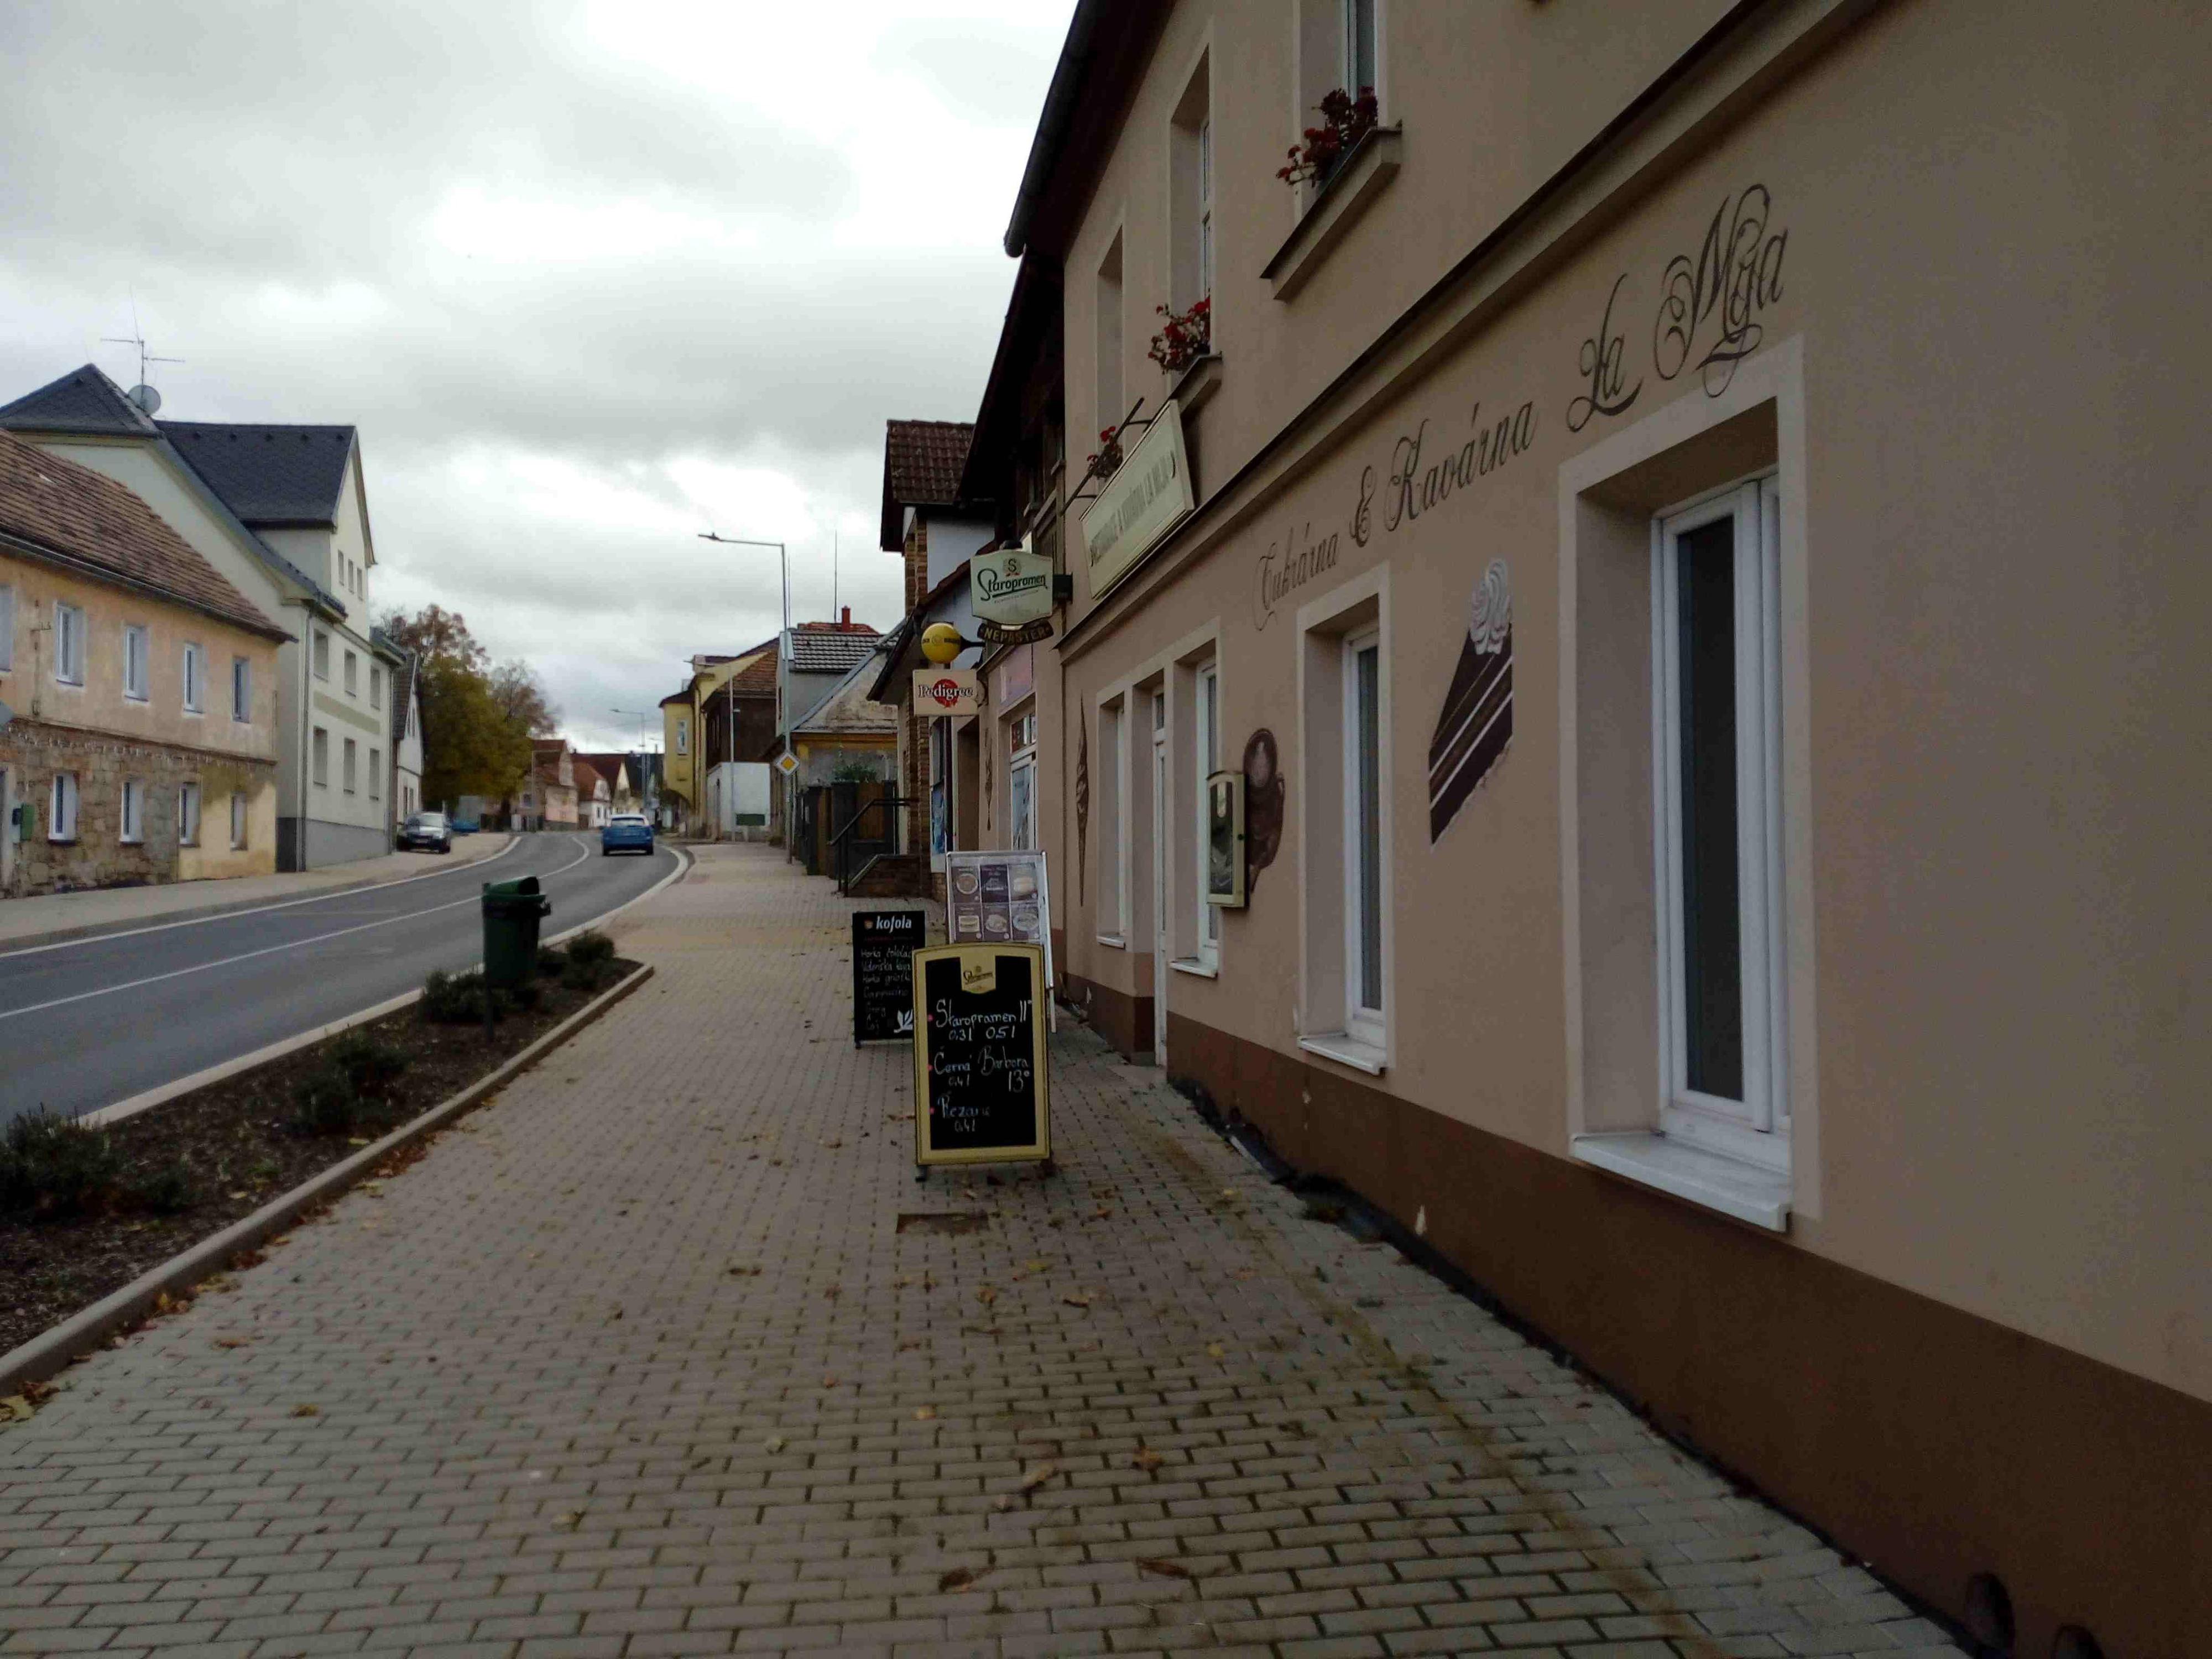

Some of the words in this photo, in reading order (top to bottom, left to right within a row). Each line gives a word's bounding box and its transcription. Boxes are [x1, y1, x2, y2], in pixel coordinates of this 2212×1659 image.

[1383, 400, 1540, 533] Kavárna
[1566, 273, 1642, 432] La
[1008, 558, 1017, 572] S
[977, 568, 1048, 601] Staropramen
[918, 684, 974, 700] Pedigree
[875, 915, 912, 933] kofola
[936, 998, 1017, 1030] Staropramen
[977, 1044, 1029, 1076] Barbora
